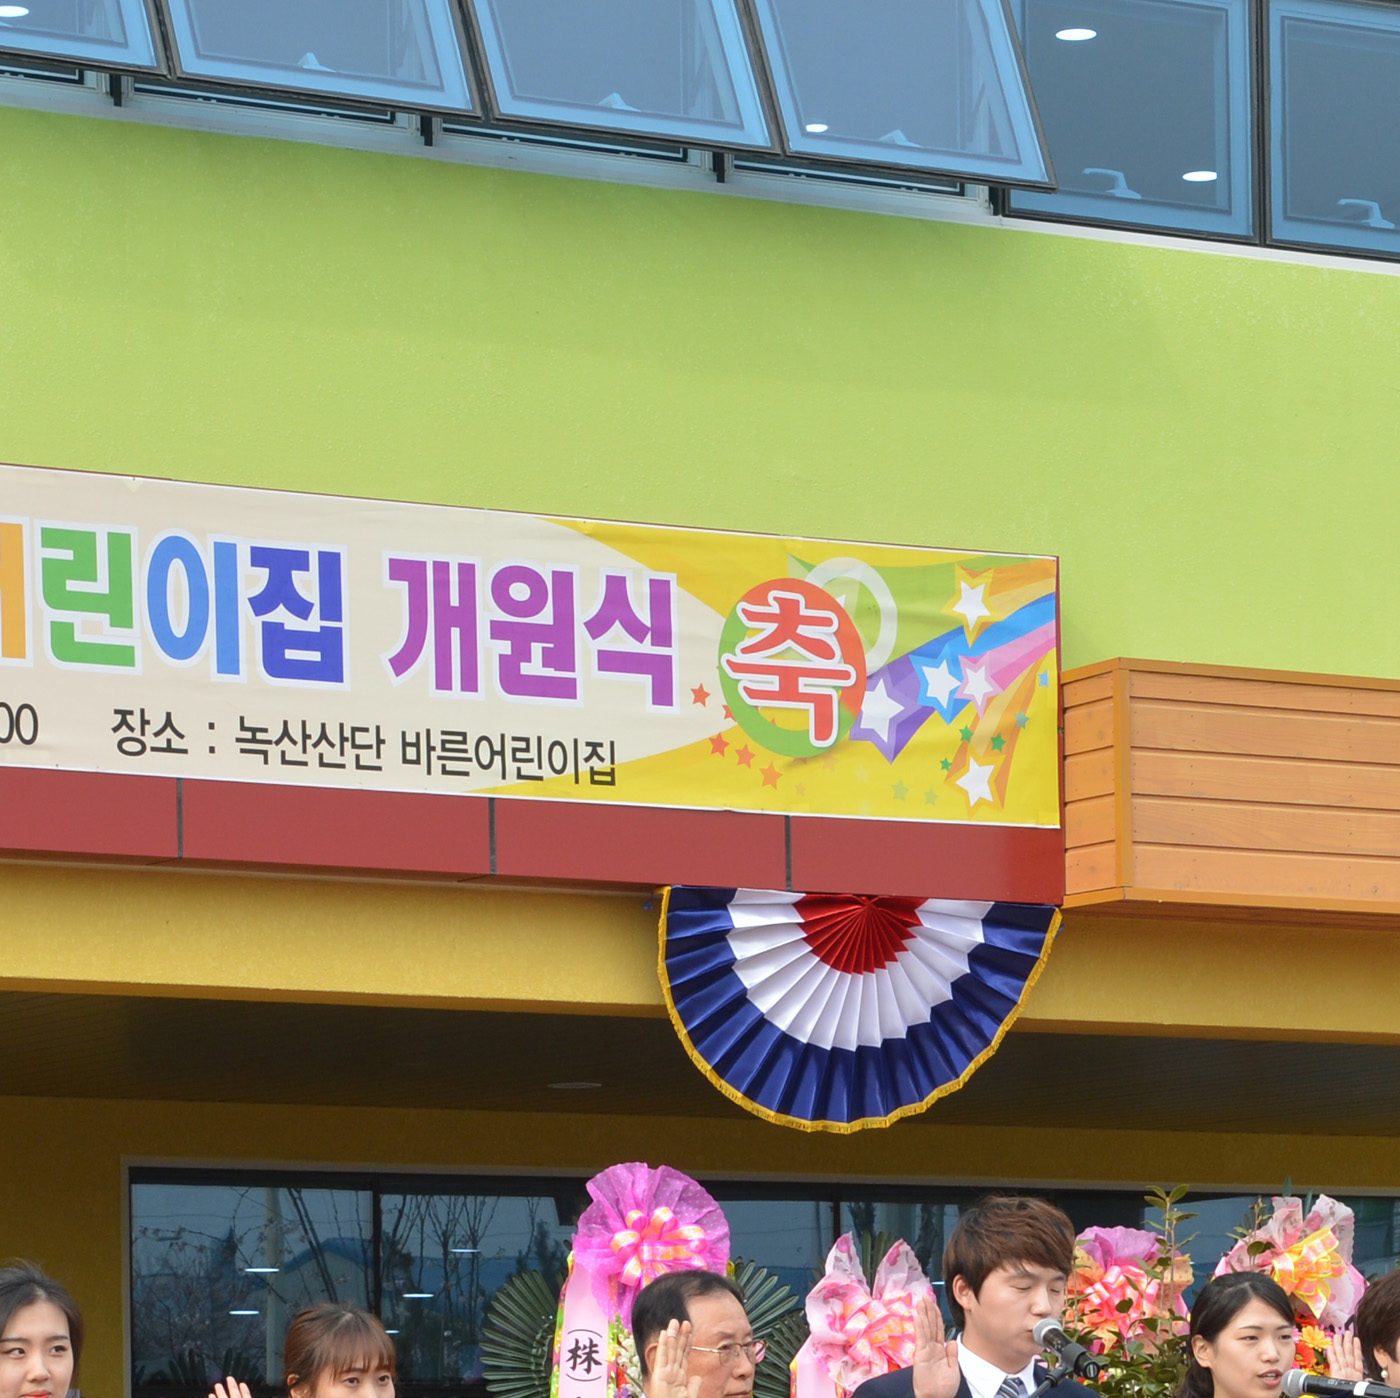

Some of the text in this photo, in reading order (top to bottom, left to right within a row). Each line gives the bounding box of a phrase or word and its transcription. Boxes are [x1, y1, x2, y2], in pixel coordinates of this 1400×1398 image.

[388, 555, 674, 707] 개원식
[727, 590, 855, 746] 축
[111, 707, 189, 757] 장소
[234, 715, 387, 772] 녹산산단
[401, 727, 618, 787] 바른어린이집
